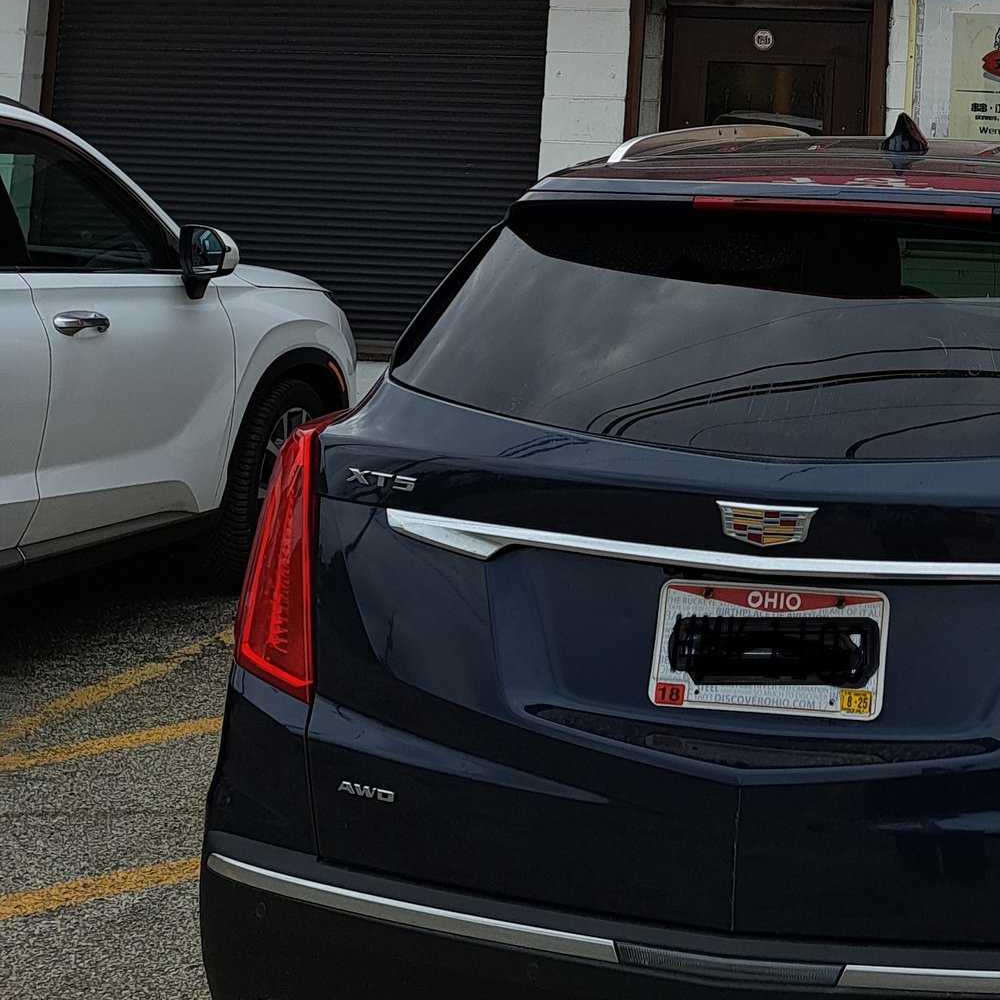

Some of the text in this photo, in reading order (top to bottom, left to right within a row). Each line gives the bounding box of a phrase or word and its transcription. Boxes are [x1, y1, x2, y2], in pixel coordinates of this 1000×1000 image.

[346, 467, 418, 492] XT5
[747, 590, 802, 611] OHIO
[657, 686, 682, 702] 18
[338, 781, 395, 803] AWD
